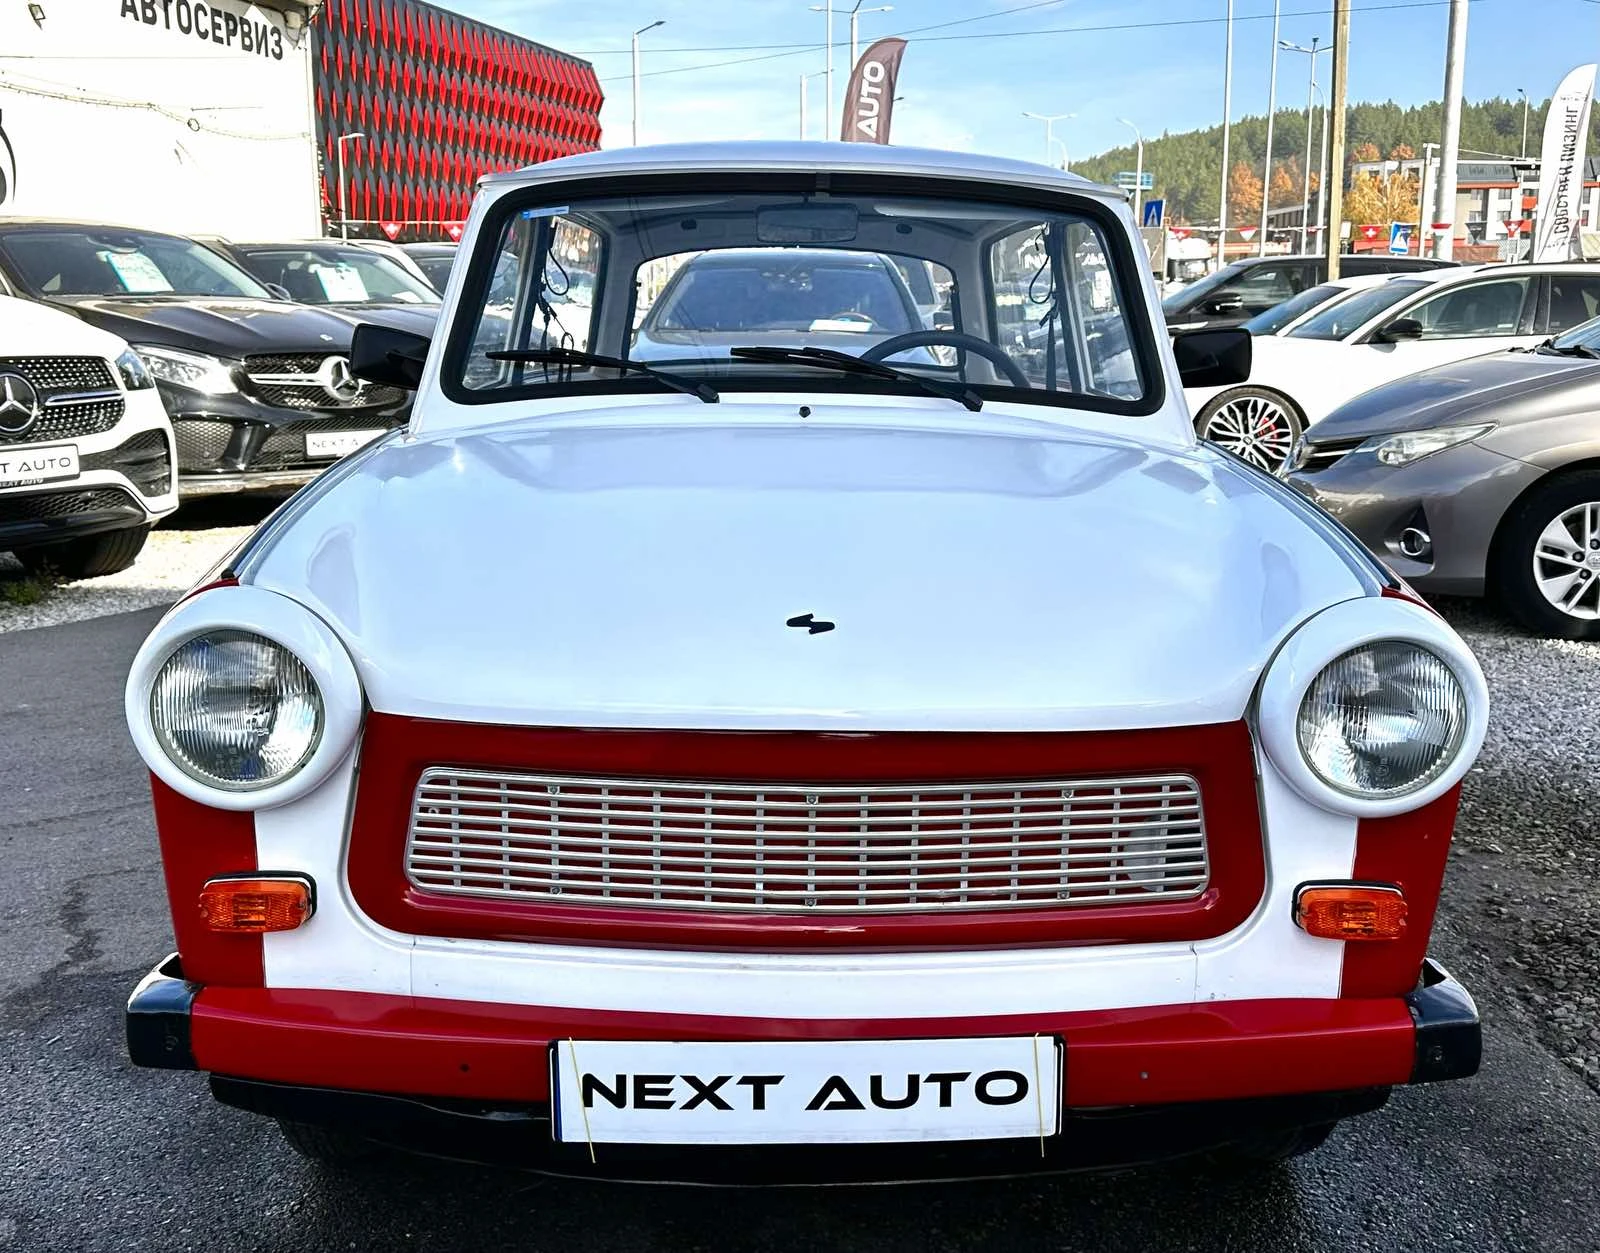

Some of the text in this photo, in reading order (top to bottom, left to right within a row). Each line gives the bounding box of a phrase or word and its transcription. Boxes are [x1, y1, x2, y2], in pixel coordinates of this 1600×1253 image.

[857, 61, 885, 139] AUTO
[18, 457, 71, 473] AUTO
[582, 1070, 1029, 1111] NEXT AUTO
